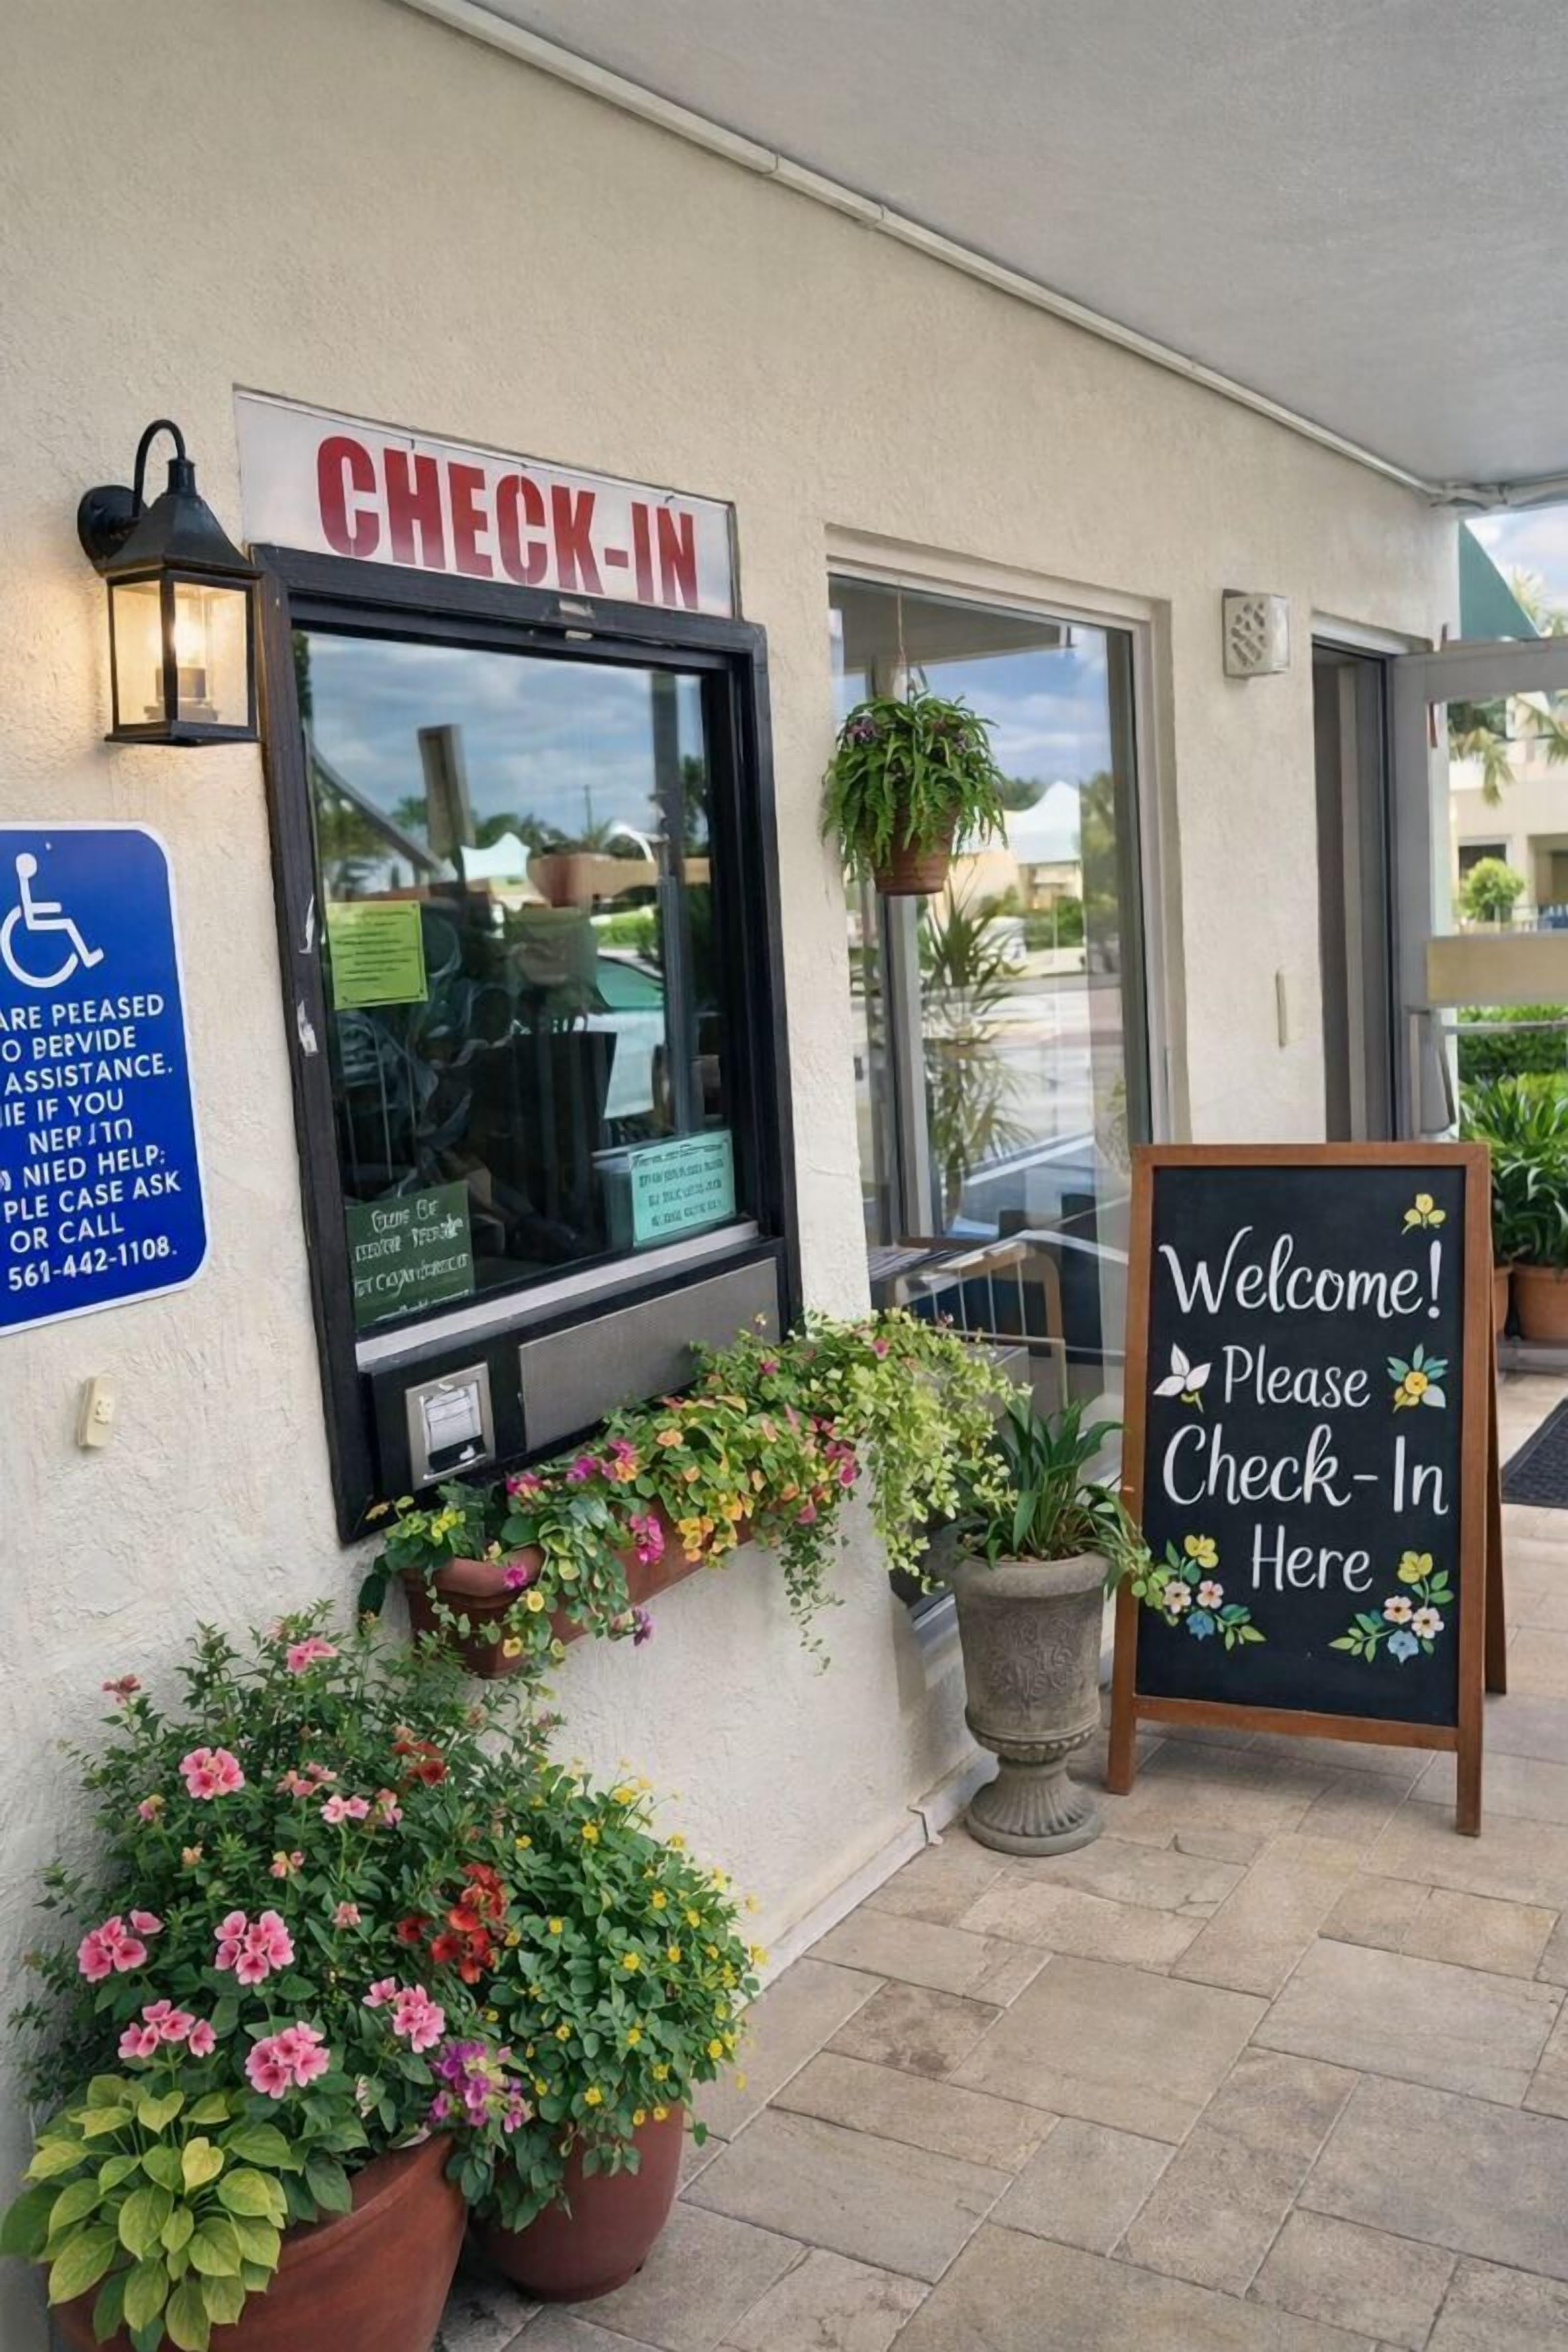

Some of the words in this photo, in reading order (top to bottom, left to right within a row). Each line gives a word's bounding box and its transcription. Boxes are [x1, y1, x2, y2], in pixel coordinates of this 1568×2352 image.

[317, 435, 699, 610] CHECK-IN
[4, 1053, 173, 1096] ASSISTANCE.
[37, 1098, 58, 1123] IF
[68, 1088, 123, 1117] YOU
[4, 1195, 49, 1224] PLE
[59, 1180, 123, 1213] CASE
[133, 1171, 181, 1200] ASK
[10, 1227, 49, 1253] OR
[59, 1212, 125, 1244] CALL
[1158, 1226, 1443, 1319] Welcome!
[1222, 1344, 1371, 1408] Please
[1251, 1523, 1373, 1591] Here
